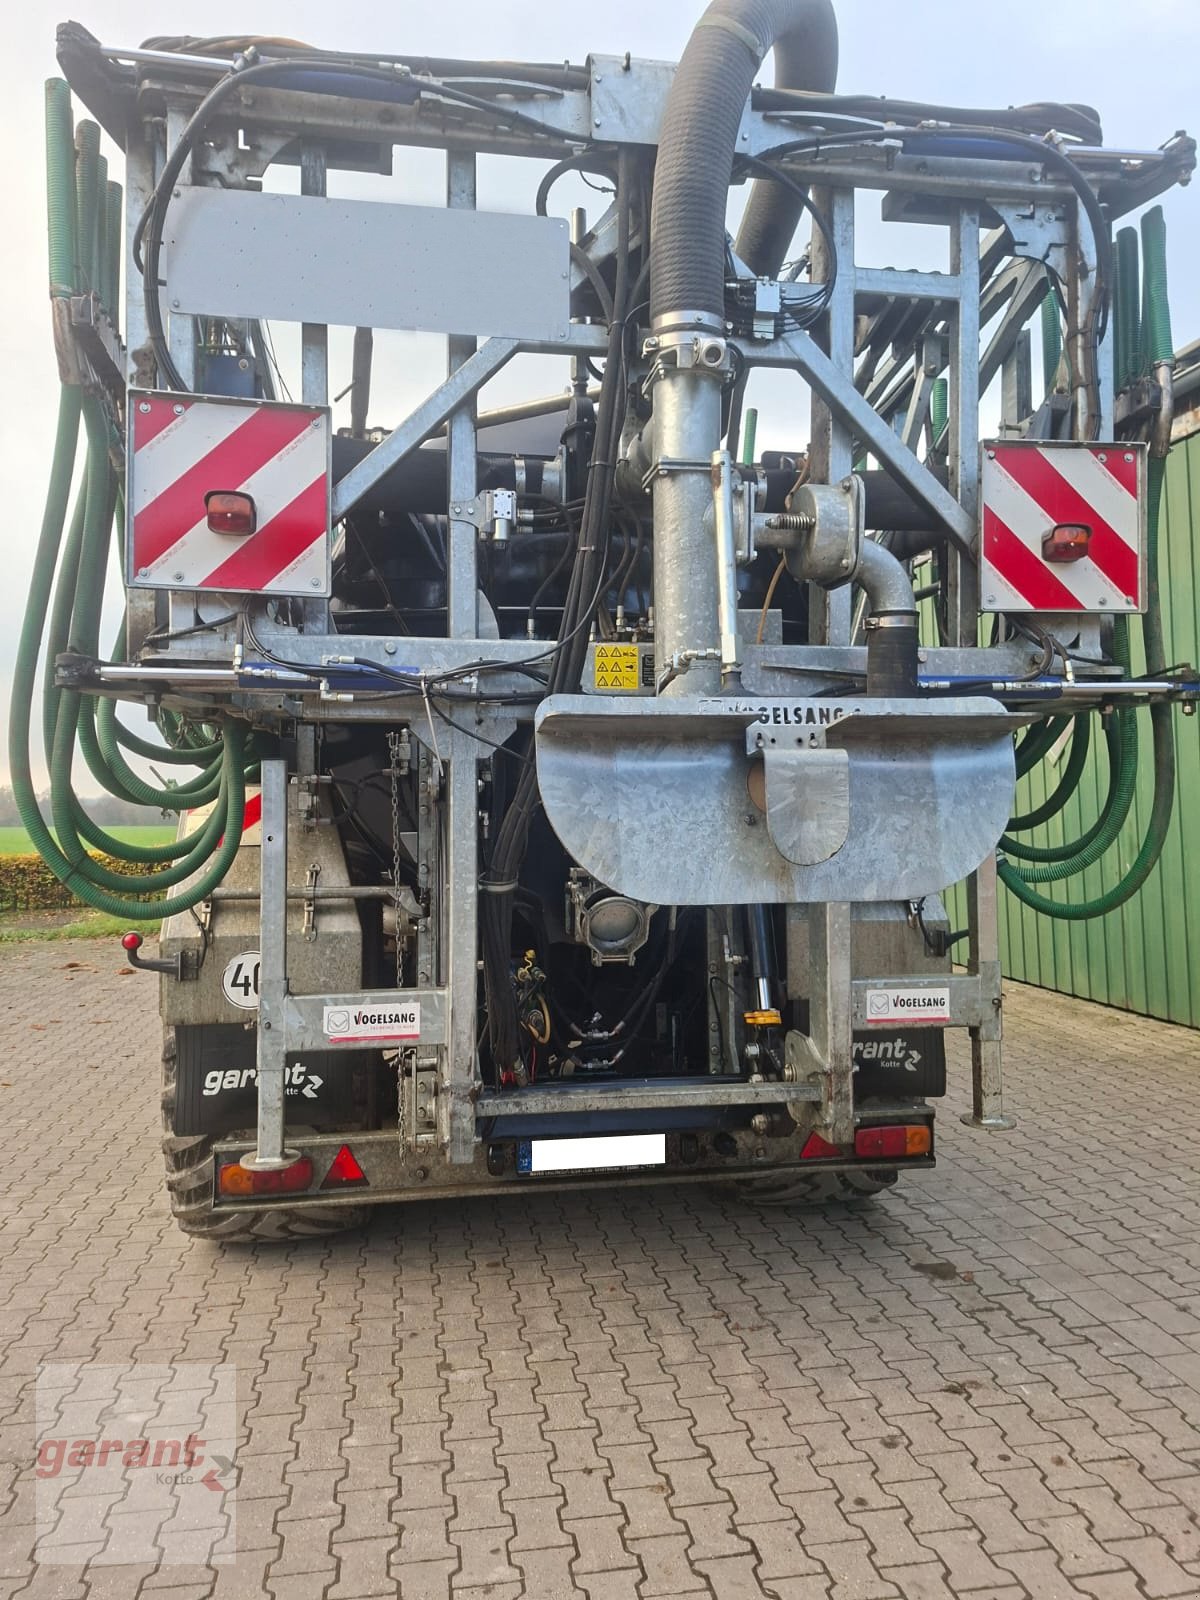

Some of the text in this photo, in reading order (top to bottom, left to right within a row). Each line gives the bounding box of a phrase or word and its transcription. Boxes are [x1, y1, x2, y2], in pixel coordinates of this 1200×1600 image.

[892, 995, 946, 1008] VOGELSANG
[354, 1011, 416, 1026] VOGELSANG
[852, 1038, 907, 1059] rant
[880, 1060, 901, 1068] Kotte
[202, 1062, 307, 1096] gart
